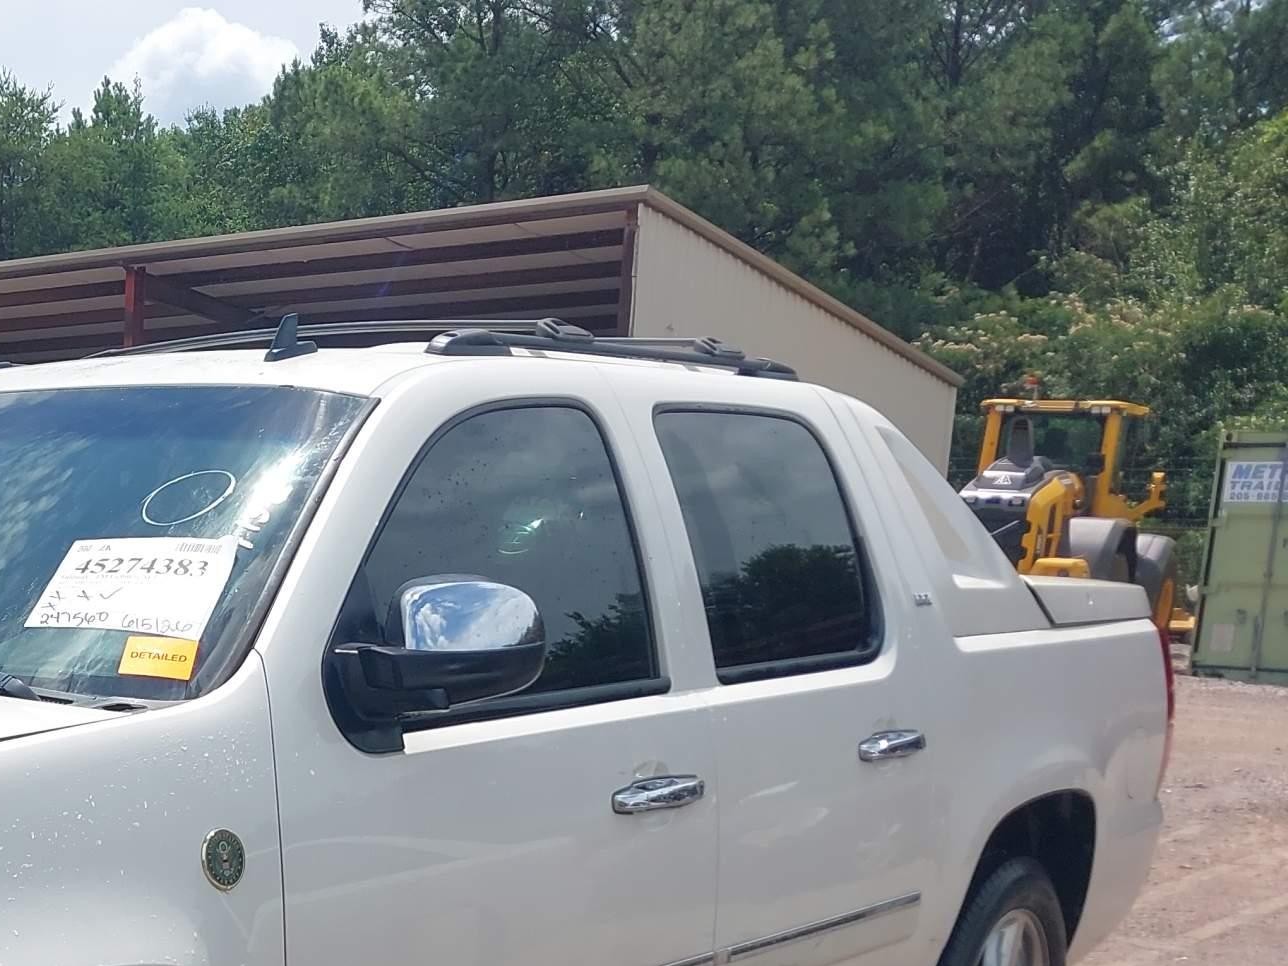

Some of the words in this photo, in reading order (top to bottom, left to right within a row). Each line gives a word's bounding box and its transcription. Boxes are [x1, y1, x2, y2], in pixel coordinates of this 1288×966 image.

[74, 557, 209, 577] 45274383
[40, 611, 109, 626] 247560
[130, 650, 188, 663] DETAILED
